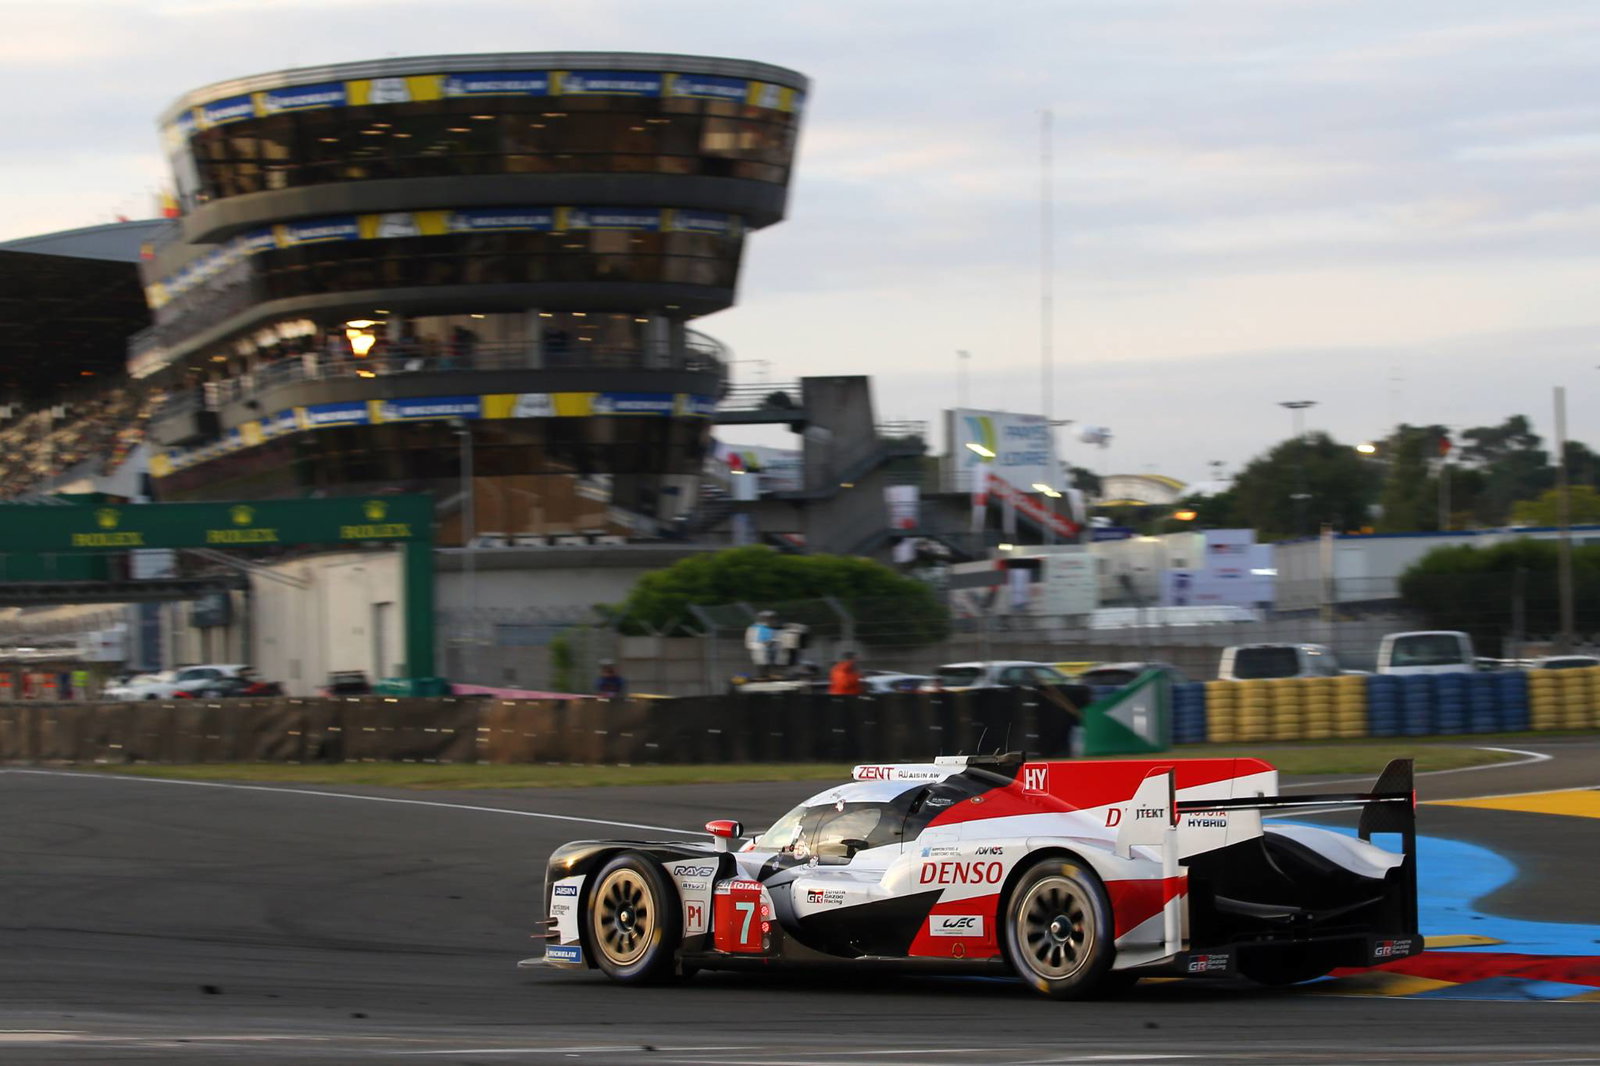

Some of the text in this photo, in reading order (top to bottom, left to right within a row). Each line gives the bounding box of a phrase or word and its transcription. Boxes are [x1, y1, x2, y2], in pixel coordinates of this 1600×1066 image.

[858, 766, 895, 780] ZENT
[1025, 768, 1047, 790] HY
[1136, 808, 1165, 820] JTEKT
[1188, 819, 1227, 828] HYBRID
[674, 866, 715, 877] RAYS
[919, 861, 1003, 884] DENSO
[556, 887, 576, 895] AISIN
[732, 881, 760, 890] TOTAL
[687, 905, 702, 928] P1
[735, 901, 755, 944] 7
[942, 918, 976, 928] WEC
